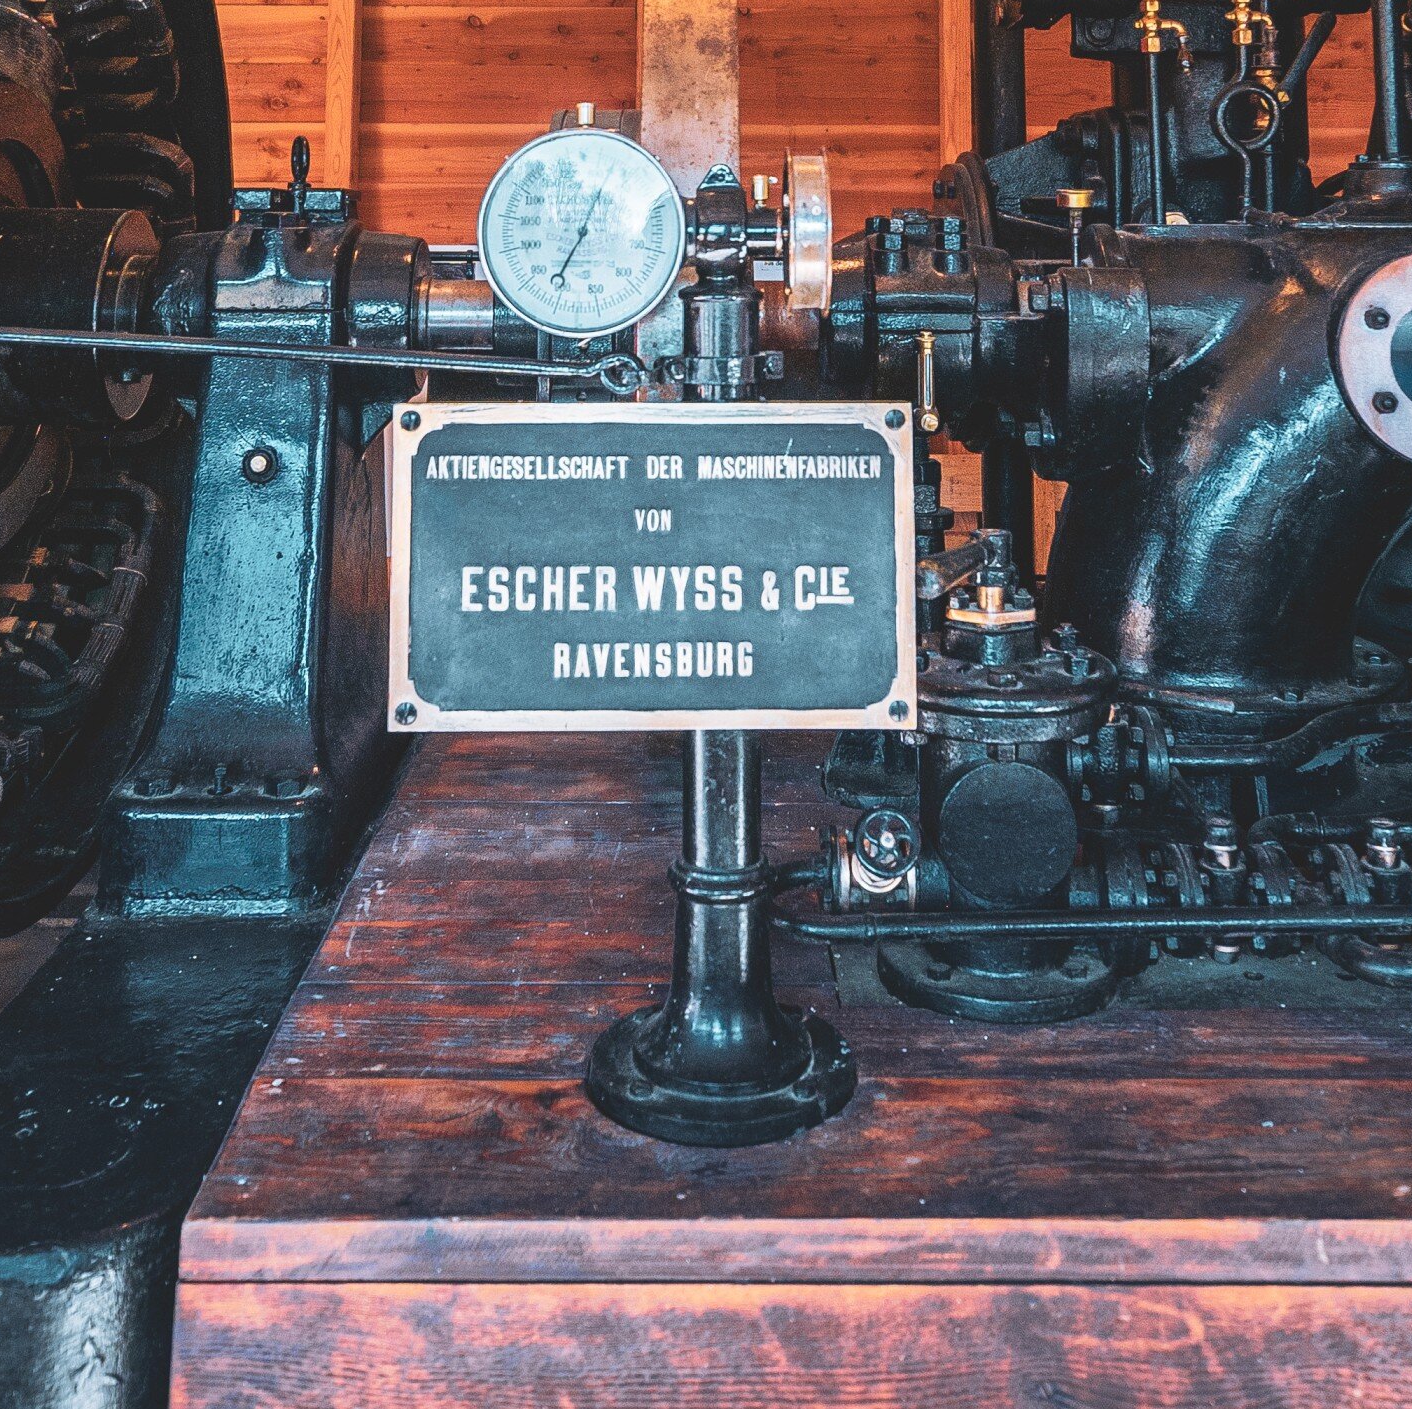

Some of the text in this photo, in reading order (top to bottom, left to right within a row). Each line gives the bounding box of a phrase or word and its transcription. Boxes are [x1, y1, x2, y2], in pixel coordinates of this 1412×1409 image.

[520, 216, 541, 226] 1050
[520, 240, 542, 249] 1000
[531, 265, 547, 275] 950
[615, 266, 632, 277] 800
[588, 284, 604, 294] 850
[426, 454, 881, 480] AKTIENGESELLSCHAFT DER MASCHINENFABRIKEN
[634, 509, 672, 533] VON
[460, 565, 617, 612] ESCHER
[632, 565, 743, 612] WYSS
[760, 570, 780, 612] &
[553, 641, 754, 679] RAVENSBURG
